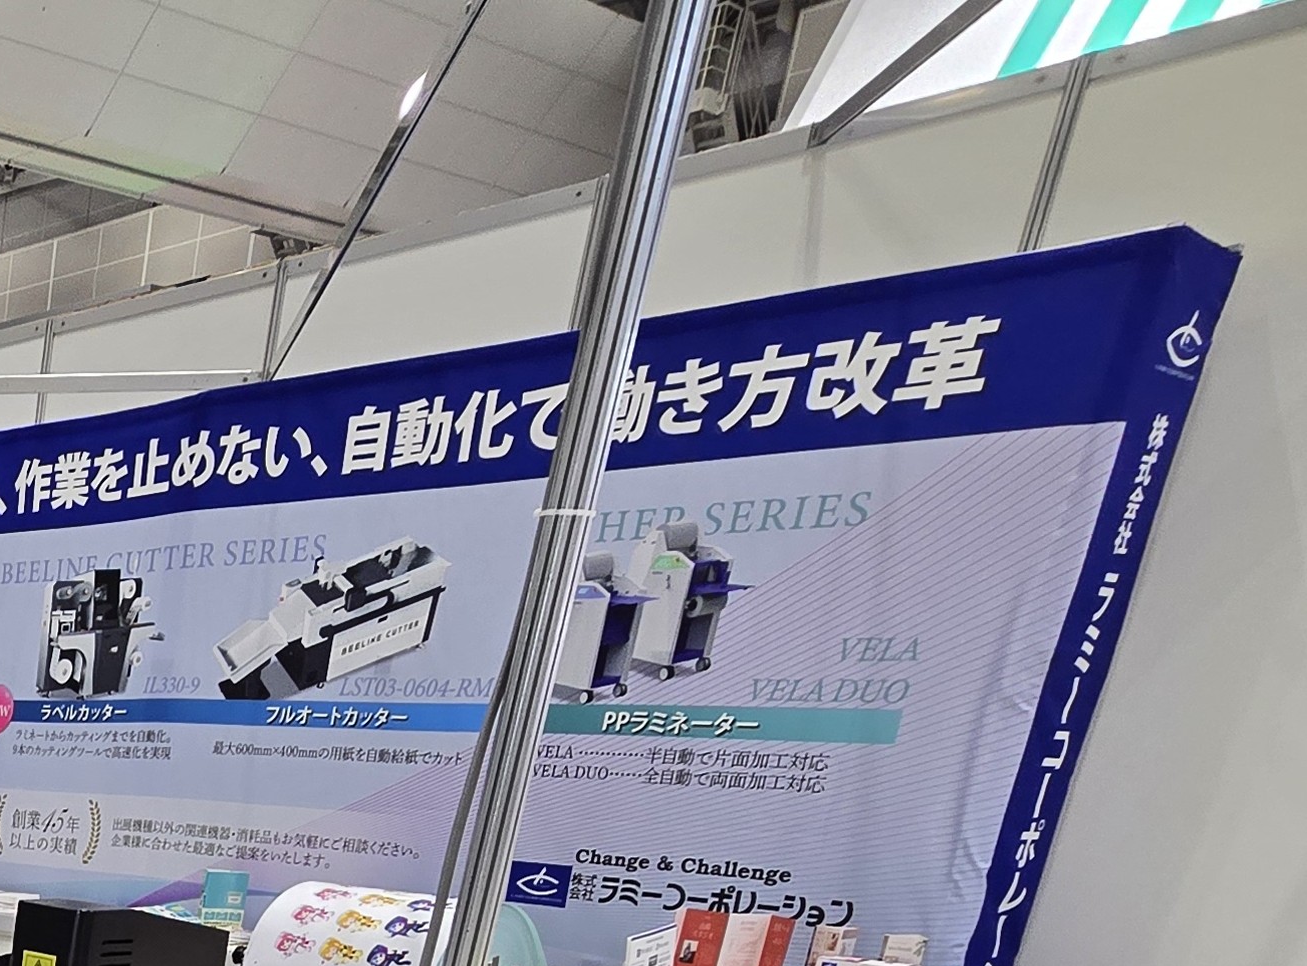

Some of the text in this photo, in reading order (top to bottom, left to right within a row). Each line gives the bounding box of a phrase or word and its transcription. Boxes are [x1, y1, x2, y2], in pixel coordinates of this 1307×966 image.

[1113, 413, 1169, 554] 株式会社
[704, 491, 872, 536] SERIES
[223, 534, 327, 567] SERIES
[841, 637, 920, 662] VELA
[752, 678, 910, 704] VELA DUO
[41, 704, 127, 721] ラベルカッター
[265, 705, 409, 727] フルオートカッター
[602, 711, 760, 736] PPラミネーター
[574, 766, 609, 780] DUO
[9, 832, 77, 855] 以上の実績
[575, 849, 792, 886] Change & Challenge
[598, 875, 854, 928] ラミーコーポレーション
